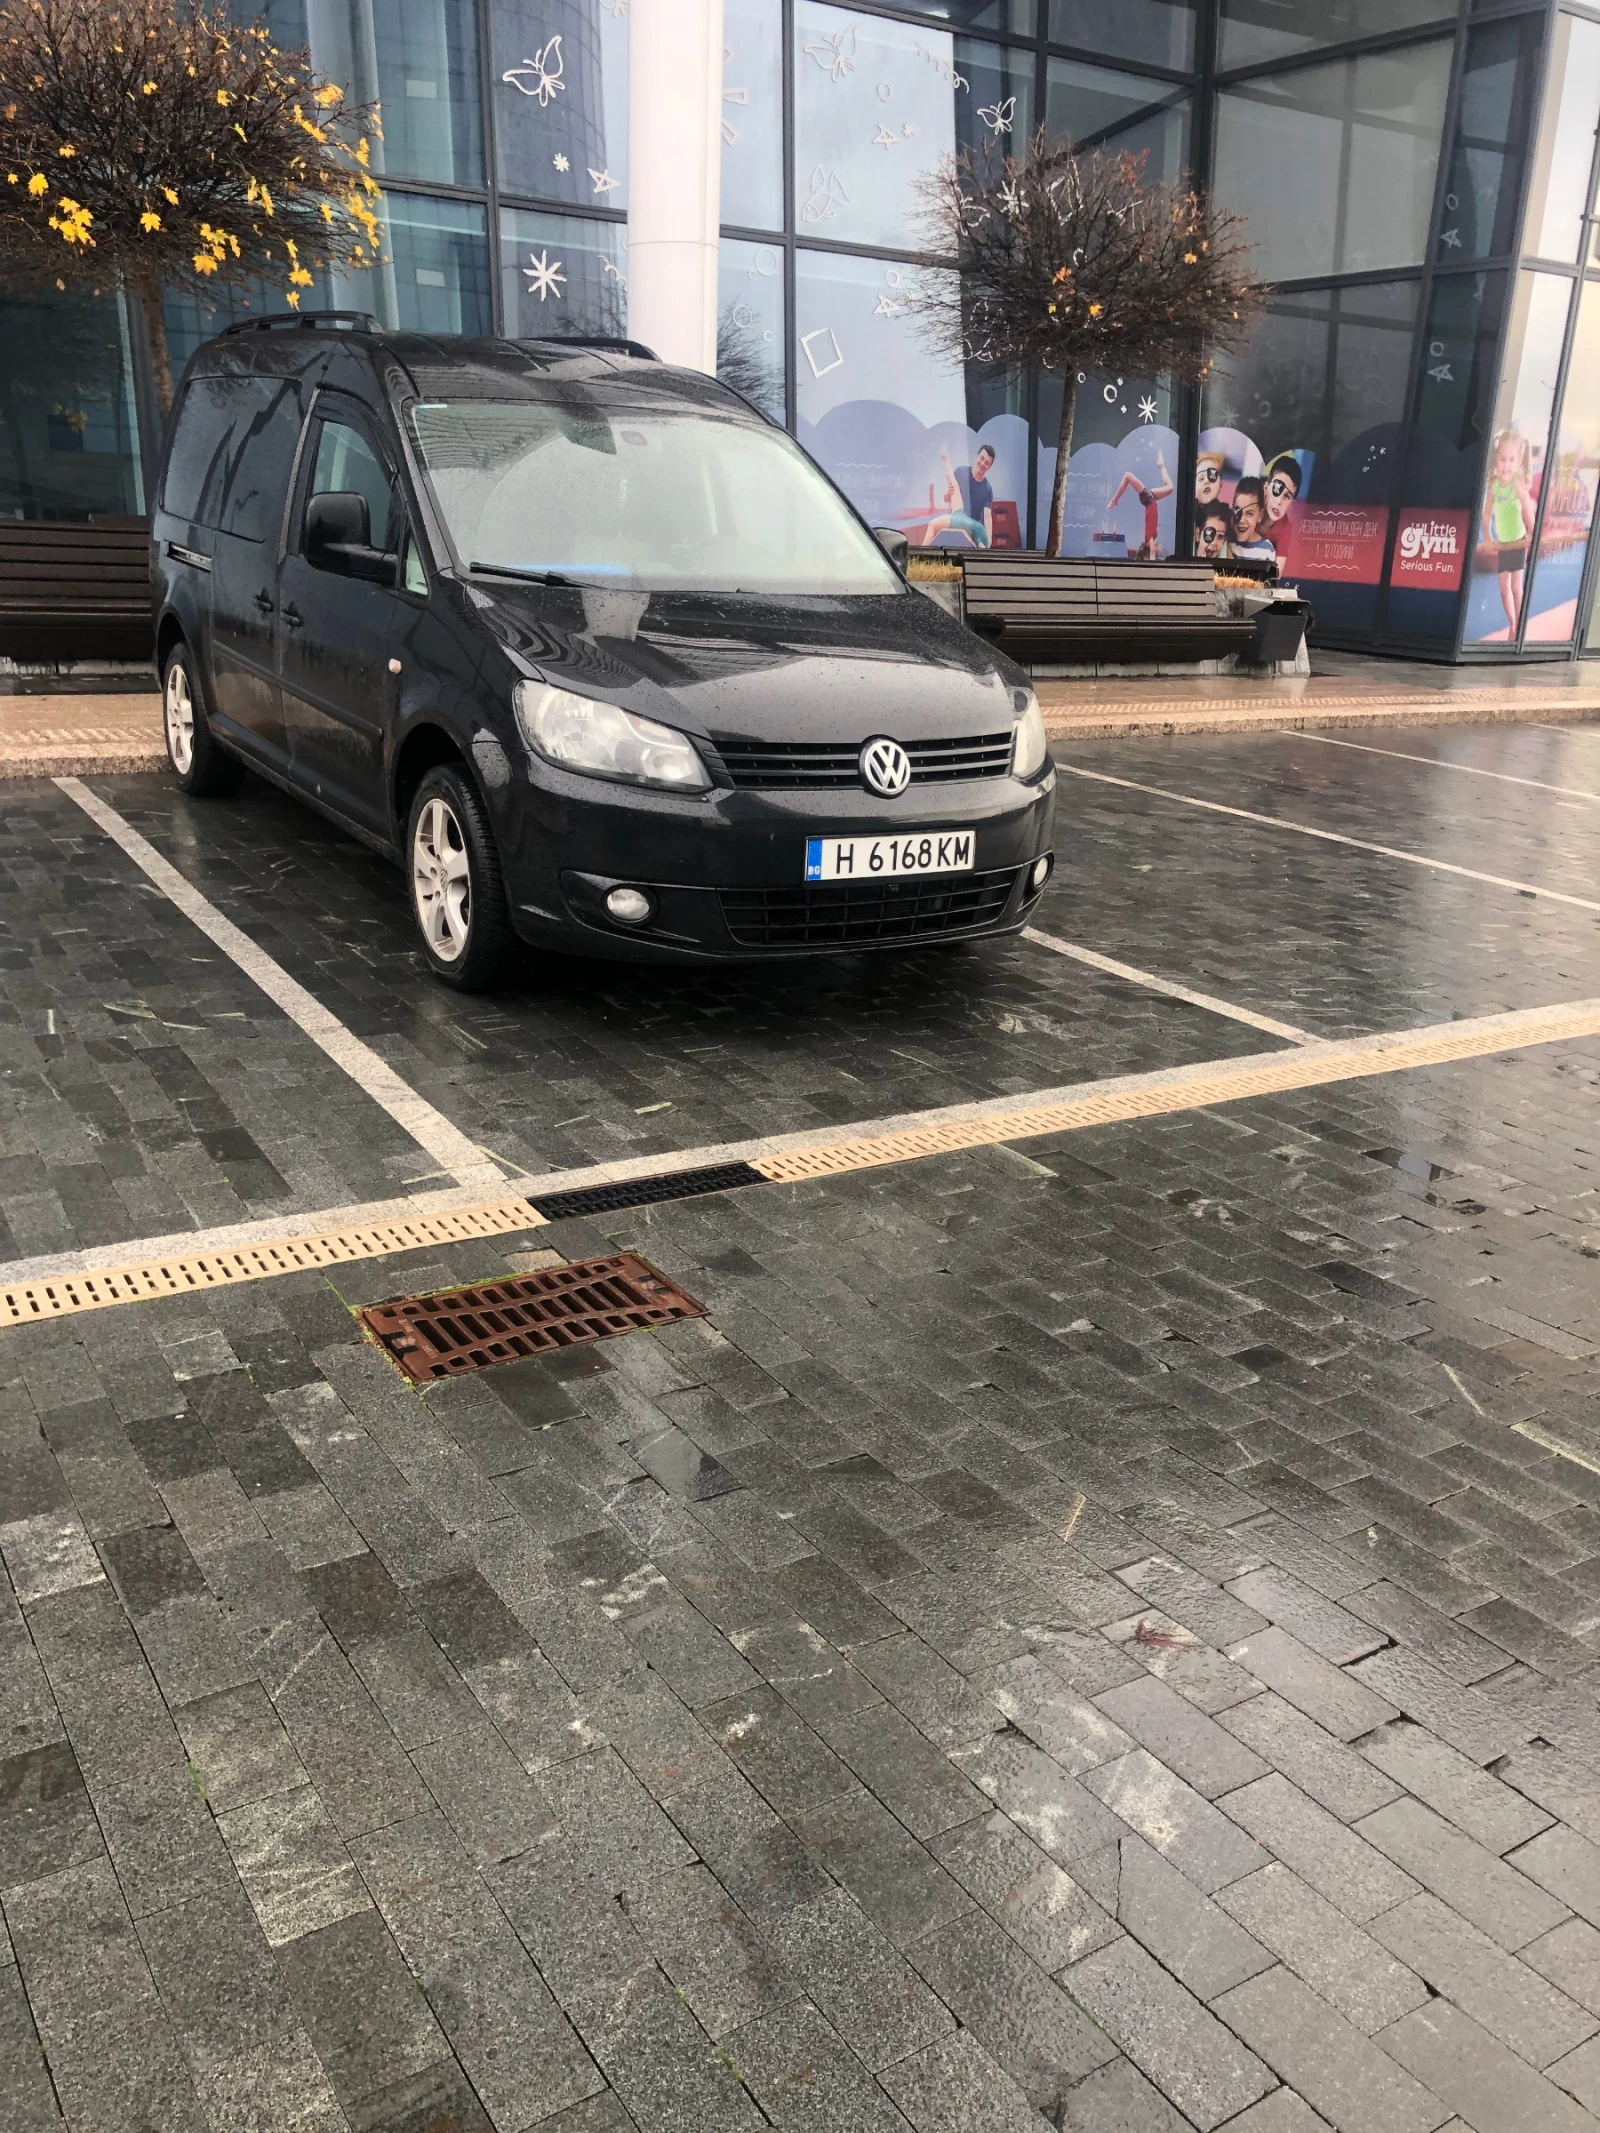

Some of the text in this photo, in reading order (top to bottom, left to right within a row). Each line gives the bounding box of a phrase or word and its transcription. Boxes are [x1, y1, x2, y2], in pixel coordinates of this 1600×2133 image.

[1363, 521, 1378, 537] ДЕН
[1423, 520, 1457, 537] Little
[1400, 526, 1457, 559] gym
[1400, 560, 1455, 573] Serious Fun.
[836, 843, 854, 874] H
[808, 865, 821, 876] BG
